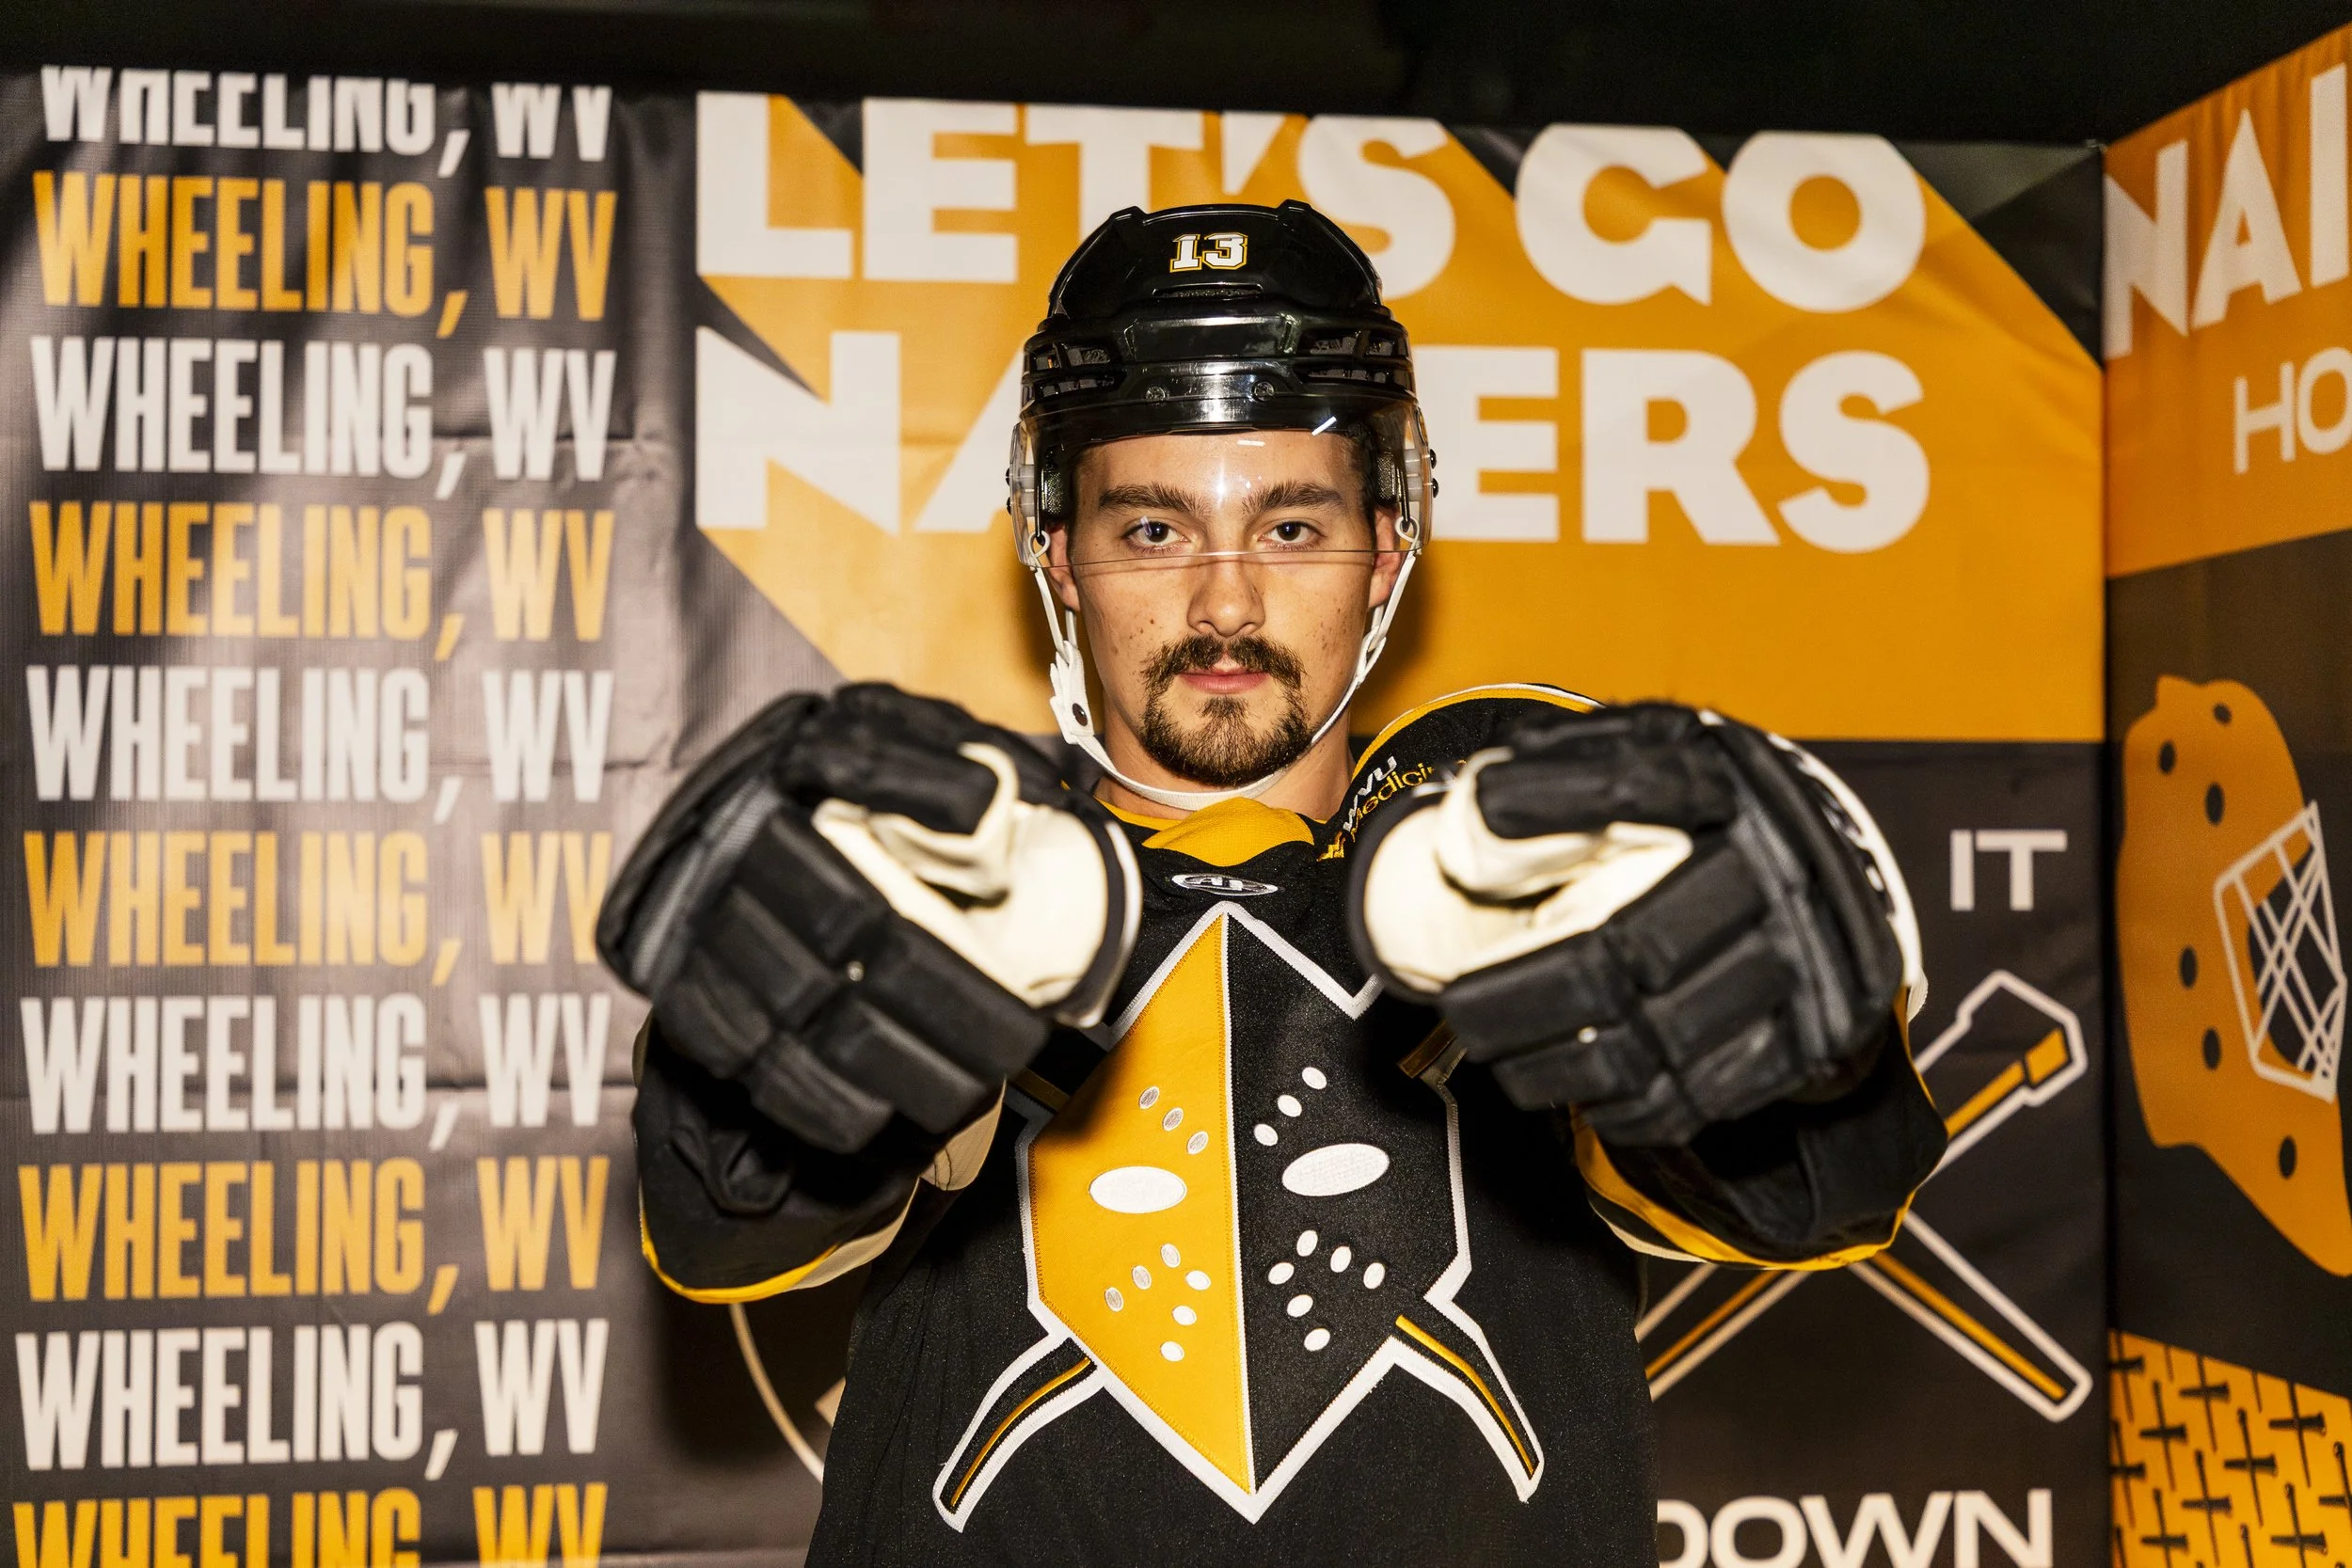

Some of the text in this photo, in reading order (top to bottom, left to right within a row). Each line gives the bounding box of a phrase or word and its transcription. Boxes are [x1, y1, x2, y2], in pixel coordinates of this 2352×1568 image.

[492, 83, 612, 161] WV
[33, 170, 616, 339] WHEELING, WV
[696, 90, 1927, 312] LET'S GO
[1169, 232, 1248, 273] 13
[31, 336, 615, 499] WHEELING, WV
[696, 325, 1931, 553] NERS
[2234, 347, 2352, 475] HO
[29, 501, 614, 660] WHEELING, WV
[26, 665, 613, 824] WHEELING, WV
[1343, 755, 1397, 832] WVU
[1350, 760, 1466, 843] Medici
[24, 831, 612, 987] WHEELING, WV
[1950, 830, 2067, 911] IT
[21, 993, 611, 1150] WHEELING, WV
[18, 1155, 609, 1316] WHEELING, WV
[15, 1319, 609, 1481] WHEELING, WV
[473, 1482, 608, 1568] WV
